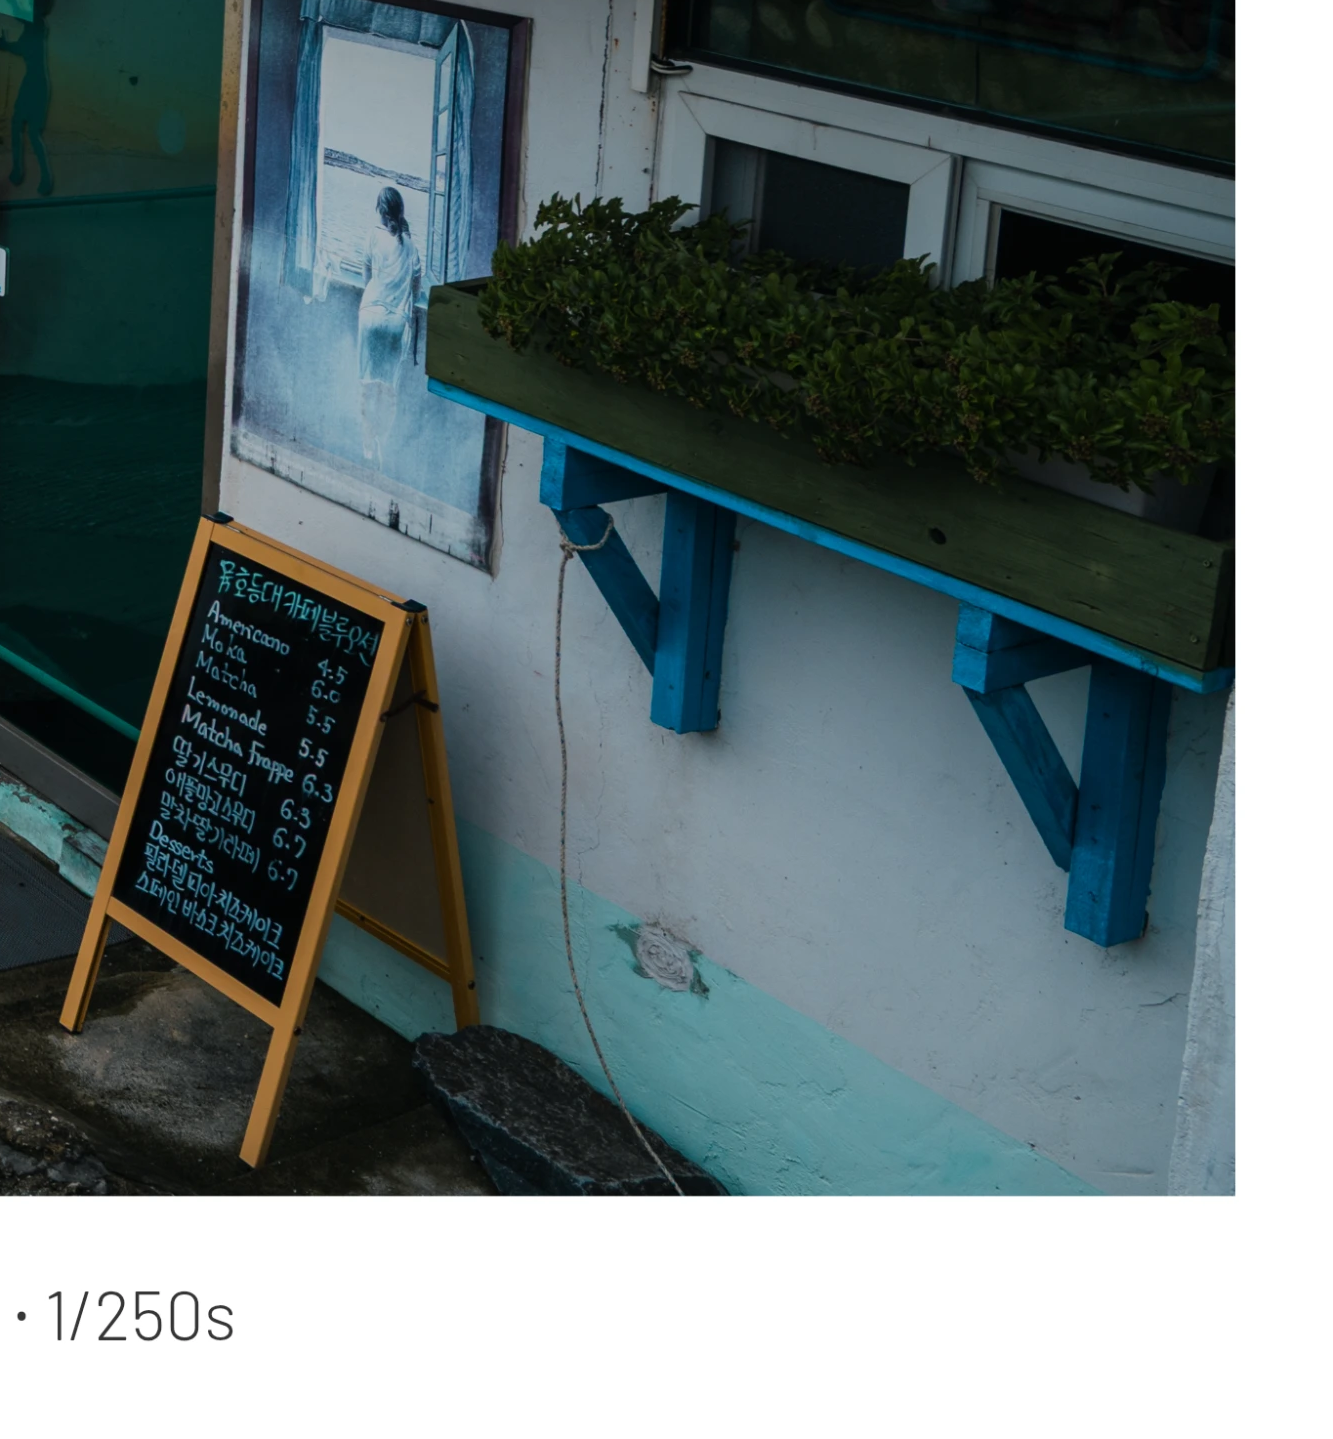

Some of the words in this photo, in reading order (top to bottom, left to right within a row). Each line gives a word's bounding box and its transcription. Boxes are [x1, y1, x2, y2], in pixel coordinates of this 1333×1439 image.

[207, 599, 290, 656] Americano
[317, 658, 348, 685] 4.5
[187, 675, 267, 736] Lemonade
[298, 737, 329, 768] 5.5
[195, 650, 257, 698] Matcha
[306, 705, 336, 734] 5.5
[311, 679, 341, 703] 6.0
[172, 735, 247, 797] 딸기스무디
[280, 798, 311, 829] 6.3
[181, 703, 243, 757] Matcha
[302, 773, 333, 803] 6.3
[149, 820, 214, 874] Desserts
[165, 768, 255, 834] 애플망고스무디
[272, 827, 306, 859] 6.7
[267, 859, 298, 890] 6.7
